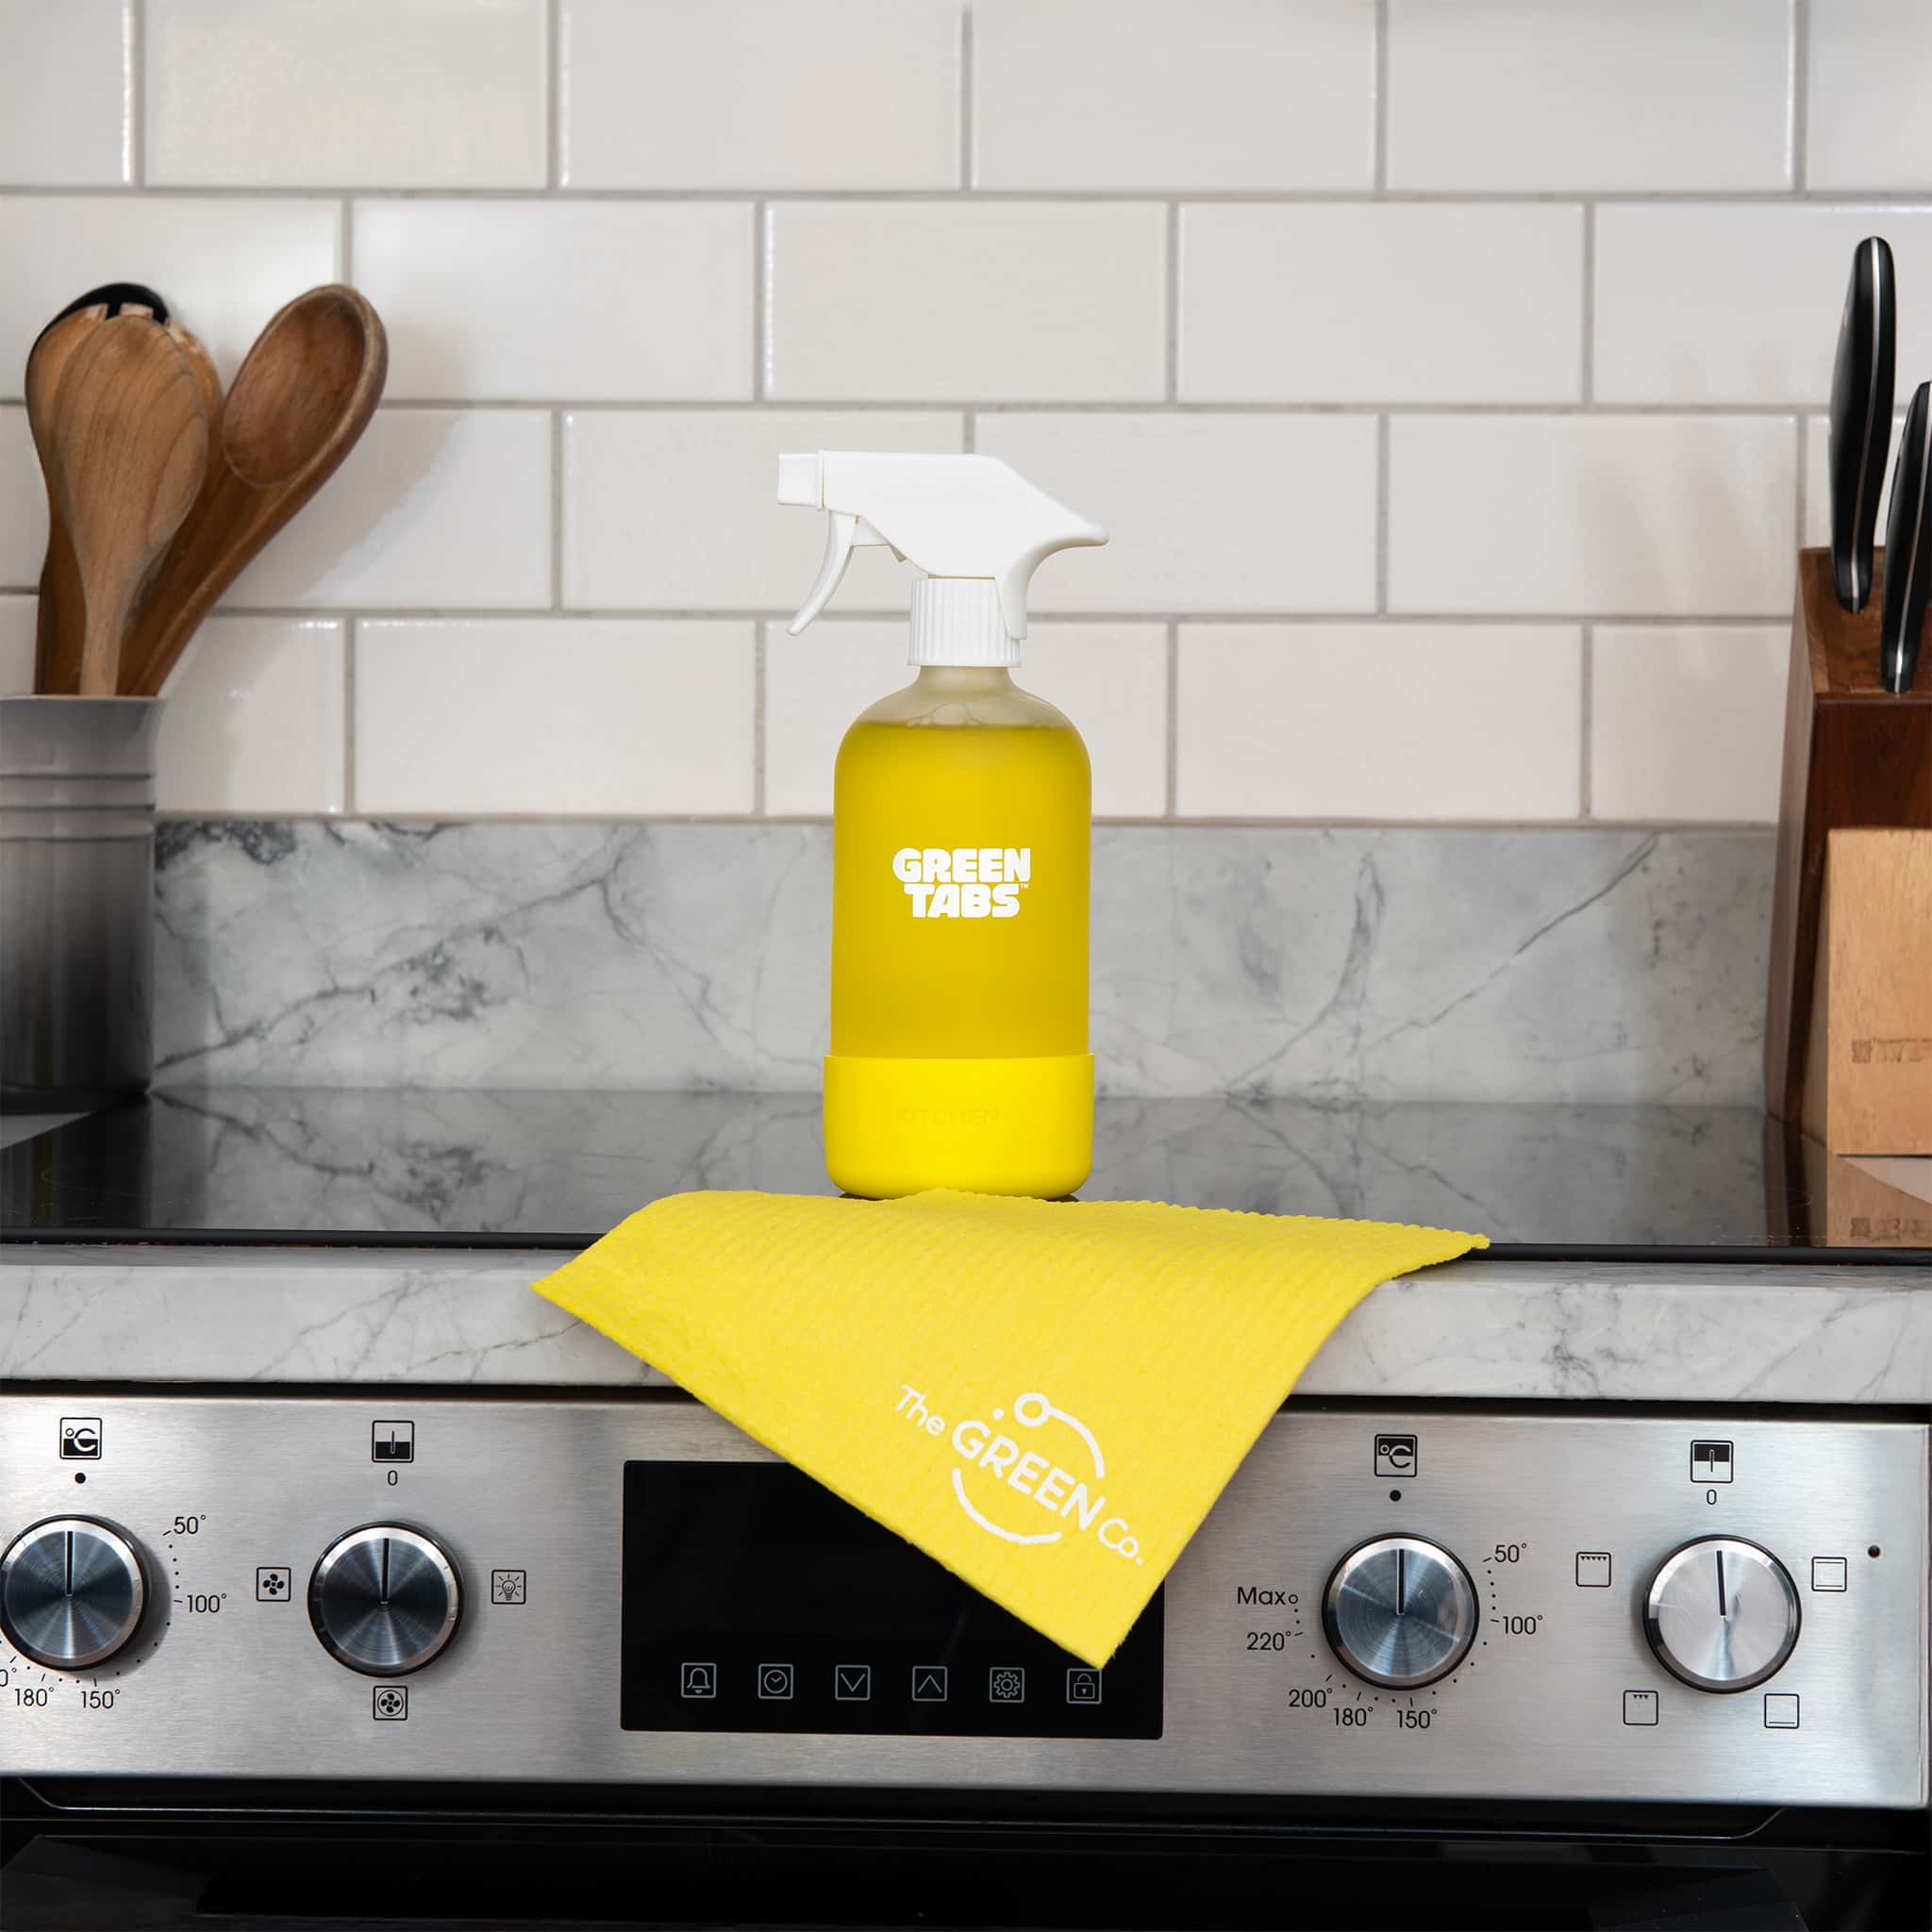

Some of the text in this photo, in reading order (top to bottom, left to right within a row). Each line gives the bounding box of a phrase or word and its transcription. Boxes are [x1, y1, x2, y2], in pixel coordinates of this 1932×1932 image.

[893, 848, 1031, 883] GREEN
[896, 1108, 1000, 1125] KITCHEN
[387, 1469, 399, 1487] 0
[896, 1384, 1143, 1565] The GREEN Co.
[1706, 1489, 1718, 1506] 0
[174, 1514, 207, 1535] 50°
[1493, 1542, 1527, 1563] 50°
[186, 1592, 227, 1614] 100°
[1502, 1614, 1543, 1636] 100°
[1246, 1630, 1291, 1651] 220°
[14, 1687, 55, 1707] 180°
[80, 1688, 122, 1709] 150°
[1289, 1688, 1333, 1708] 200°
[1333, 1707, 1374, 1727] 180°
[1396, 1707, 1438, 1729] 150°
